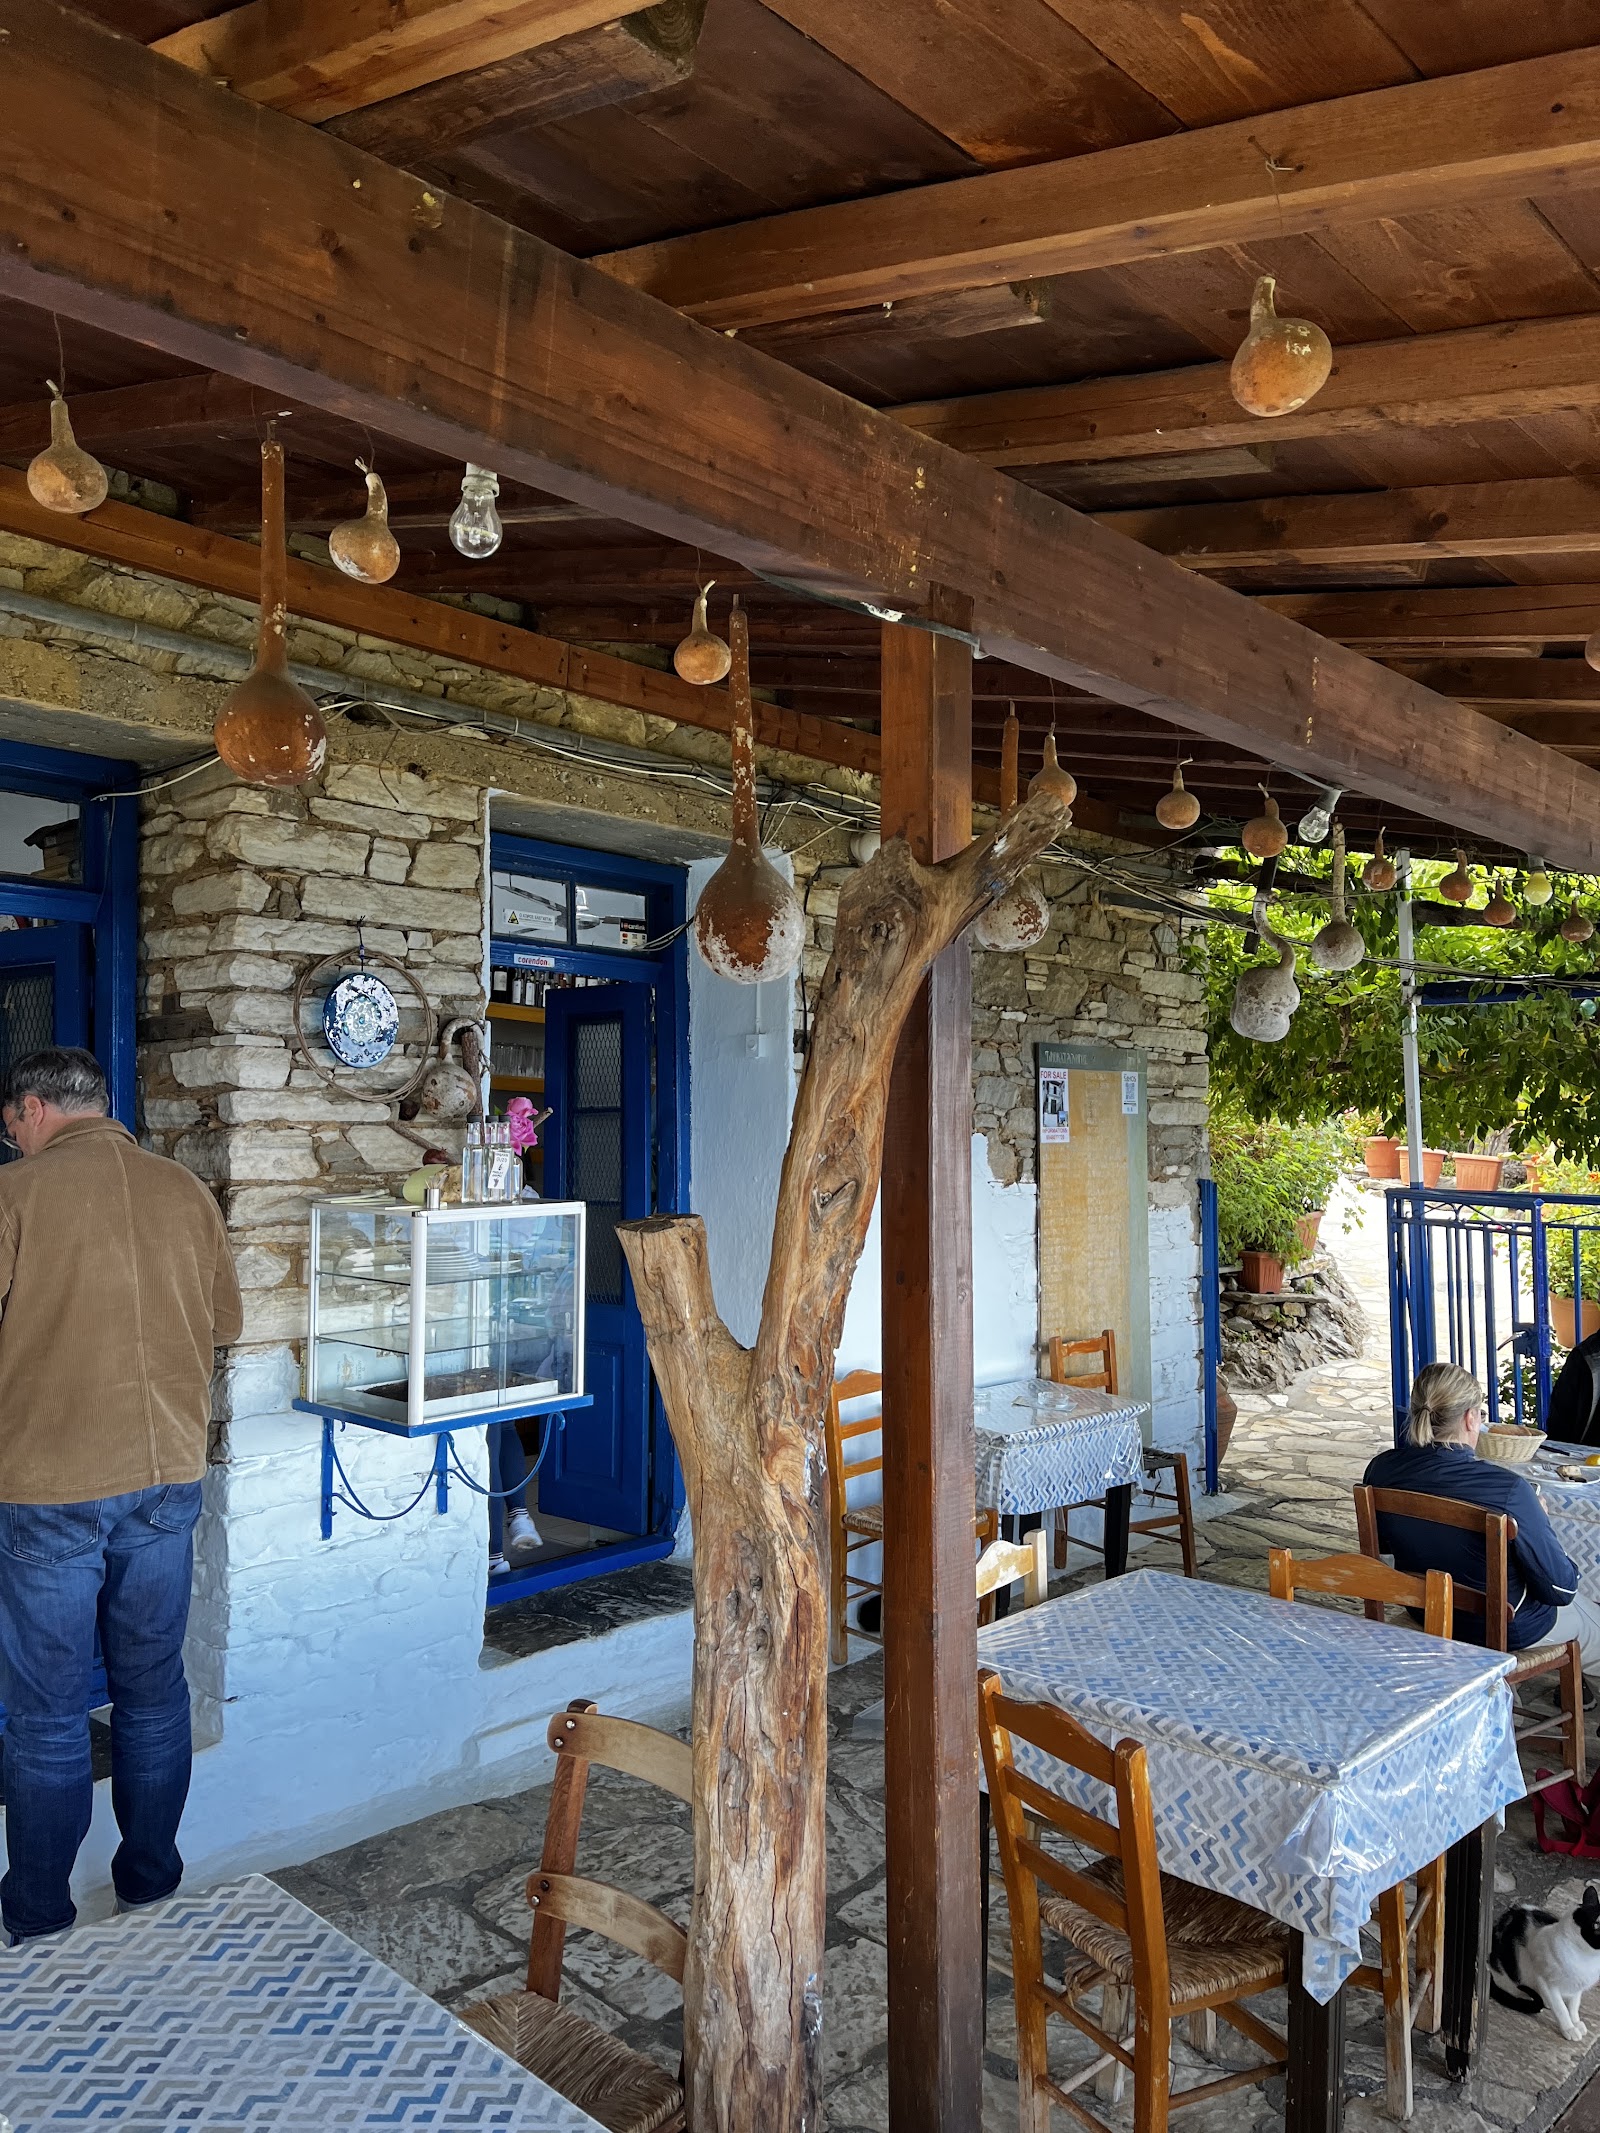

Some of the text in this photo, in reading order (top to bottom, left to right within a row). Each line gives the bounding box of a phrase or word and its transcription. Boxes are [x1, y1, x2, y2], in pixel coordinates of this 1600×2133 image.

[11, 919, 15, 927] 2
[1040, 1071, 1067, 1080] FOR SALE
